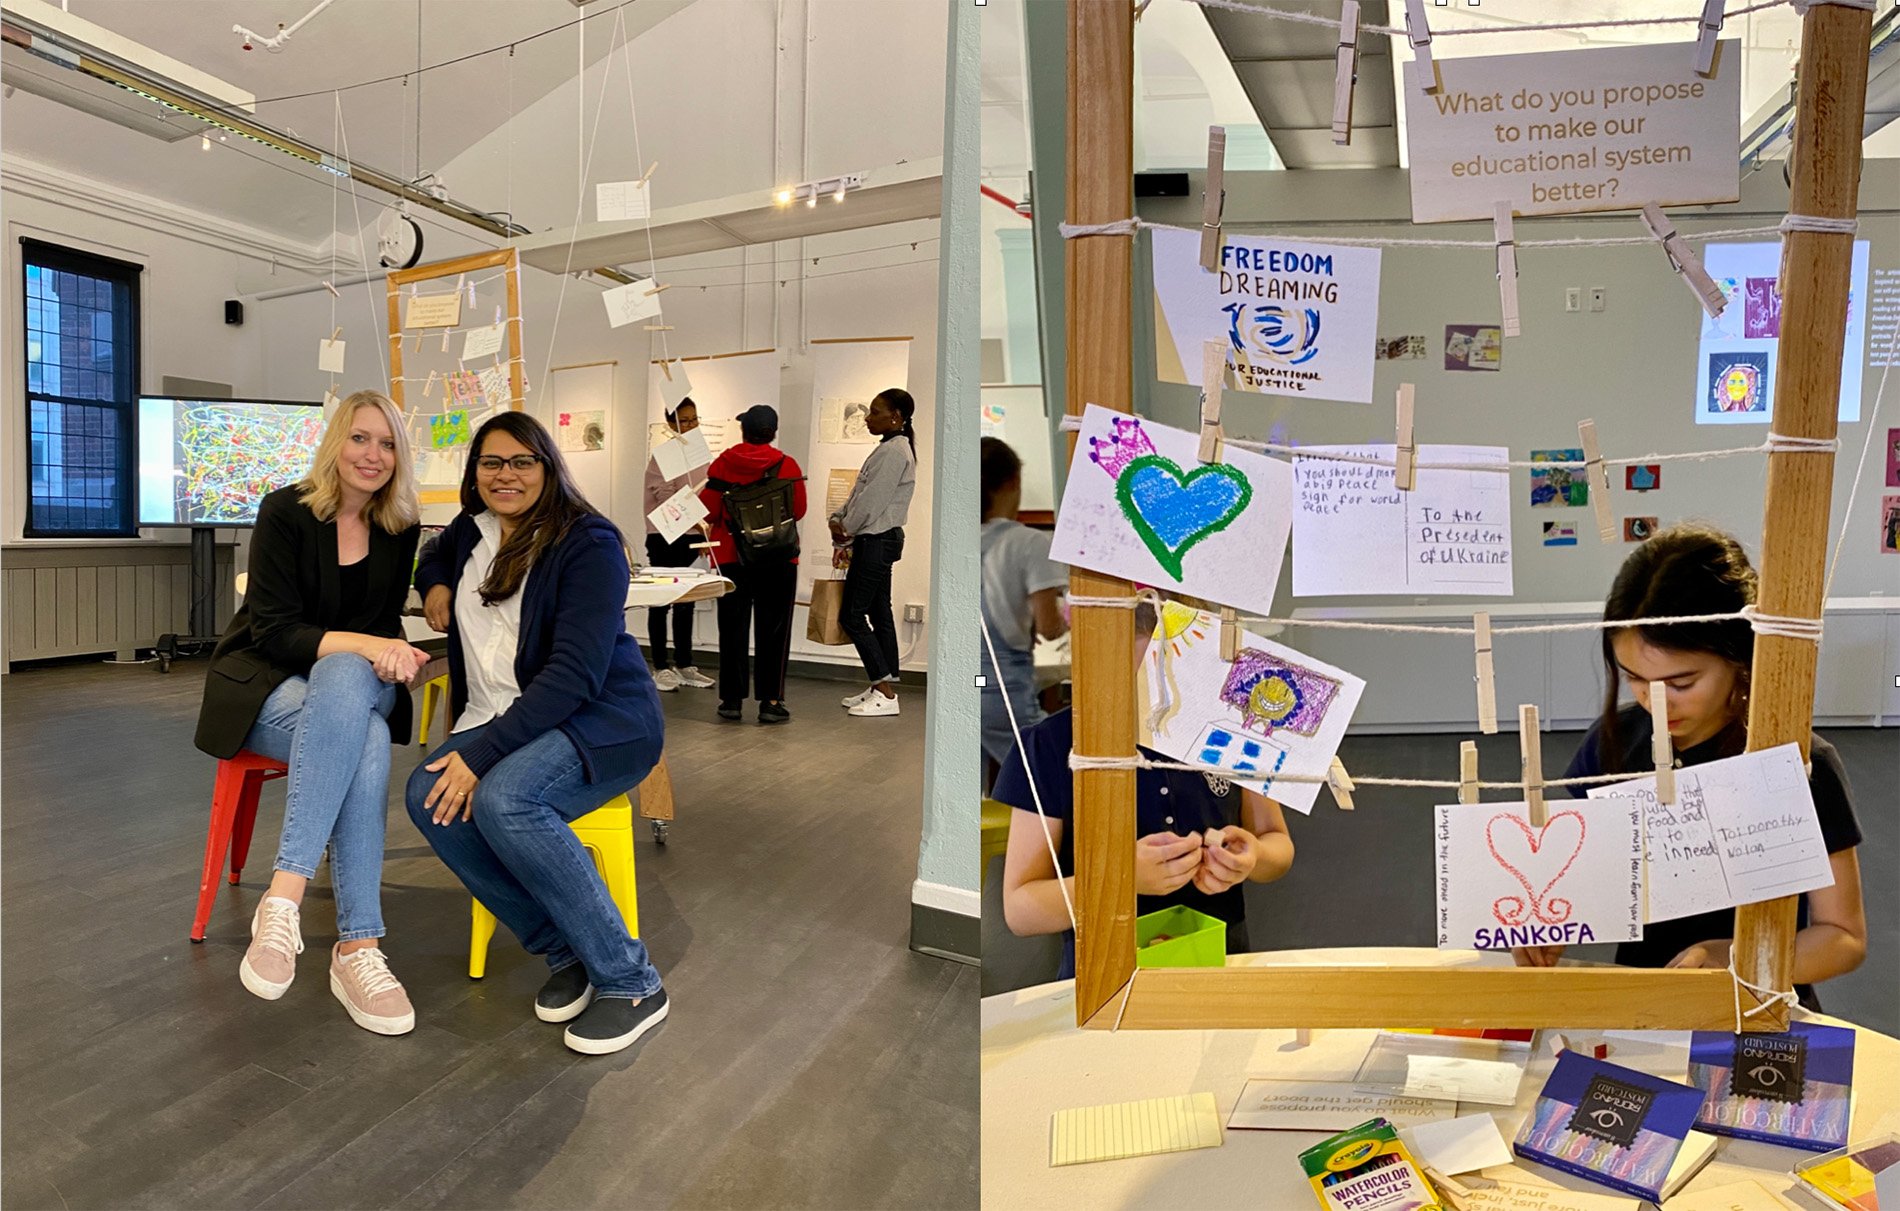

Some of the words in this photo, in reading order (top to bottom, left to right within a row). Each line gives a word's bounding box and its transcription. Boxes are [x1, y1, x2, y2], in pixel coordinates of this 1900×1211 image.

[1435, 91, 1503, 115] What
[1512, 88, 1543, 110] do
[1550, 88, 1595, 112] you
[1603, 81, 1704, 109] propose
[1495, 124, 1520, 143] to
[1528, 117, 1597, 142] make
[1604, 117, 1645, 136] our
[1451, 148, 1596, 177] educational
[1604, 144, 1692, 171] system
[1532, 178, 1620, 203] better?
[1221, 246, 1333, 276] FREEDOM
[1220, 271, 1339, 303] DREAMING
[1246, 376, 1306, 391] JUSTICE
[1250, 365, 1322, 381] EDUCATIONAL
[1302, 491, 1329, 504] sign
[1340, 494, 1362, 505] for
[1421, 507, 1441, 522] To
[1452, 507, 1483, 522] the
[1420, 548, 1436, 566] of
[1438, 808, 1449, 841] future
[1684, 841, 1719, 860] need
[1473, 923, 1595, 950] SANKOFA
[1744, 1038, 1798, 1053] POSTCARD
[1597, 1083, 1646, 1104] POSTCARD
[1259, 1102, 1327, 1112] propose
[1699, 1101, 1842, 1140] WATERCOLOU
[1332, 1167, 1411, 1201] WATERCOLOR
[1343, 1180, 1412, 1210] PENCILS
[1516, 1189, 1549, 1199] and
